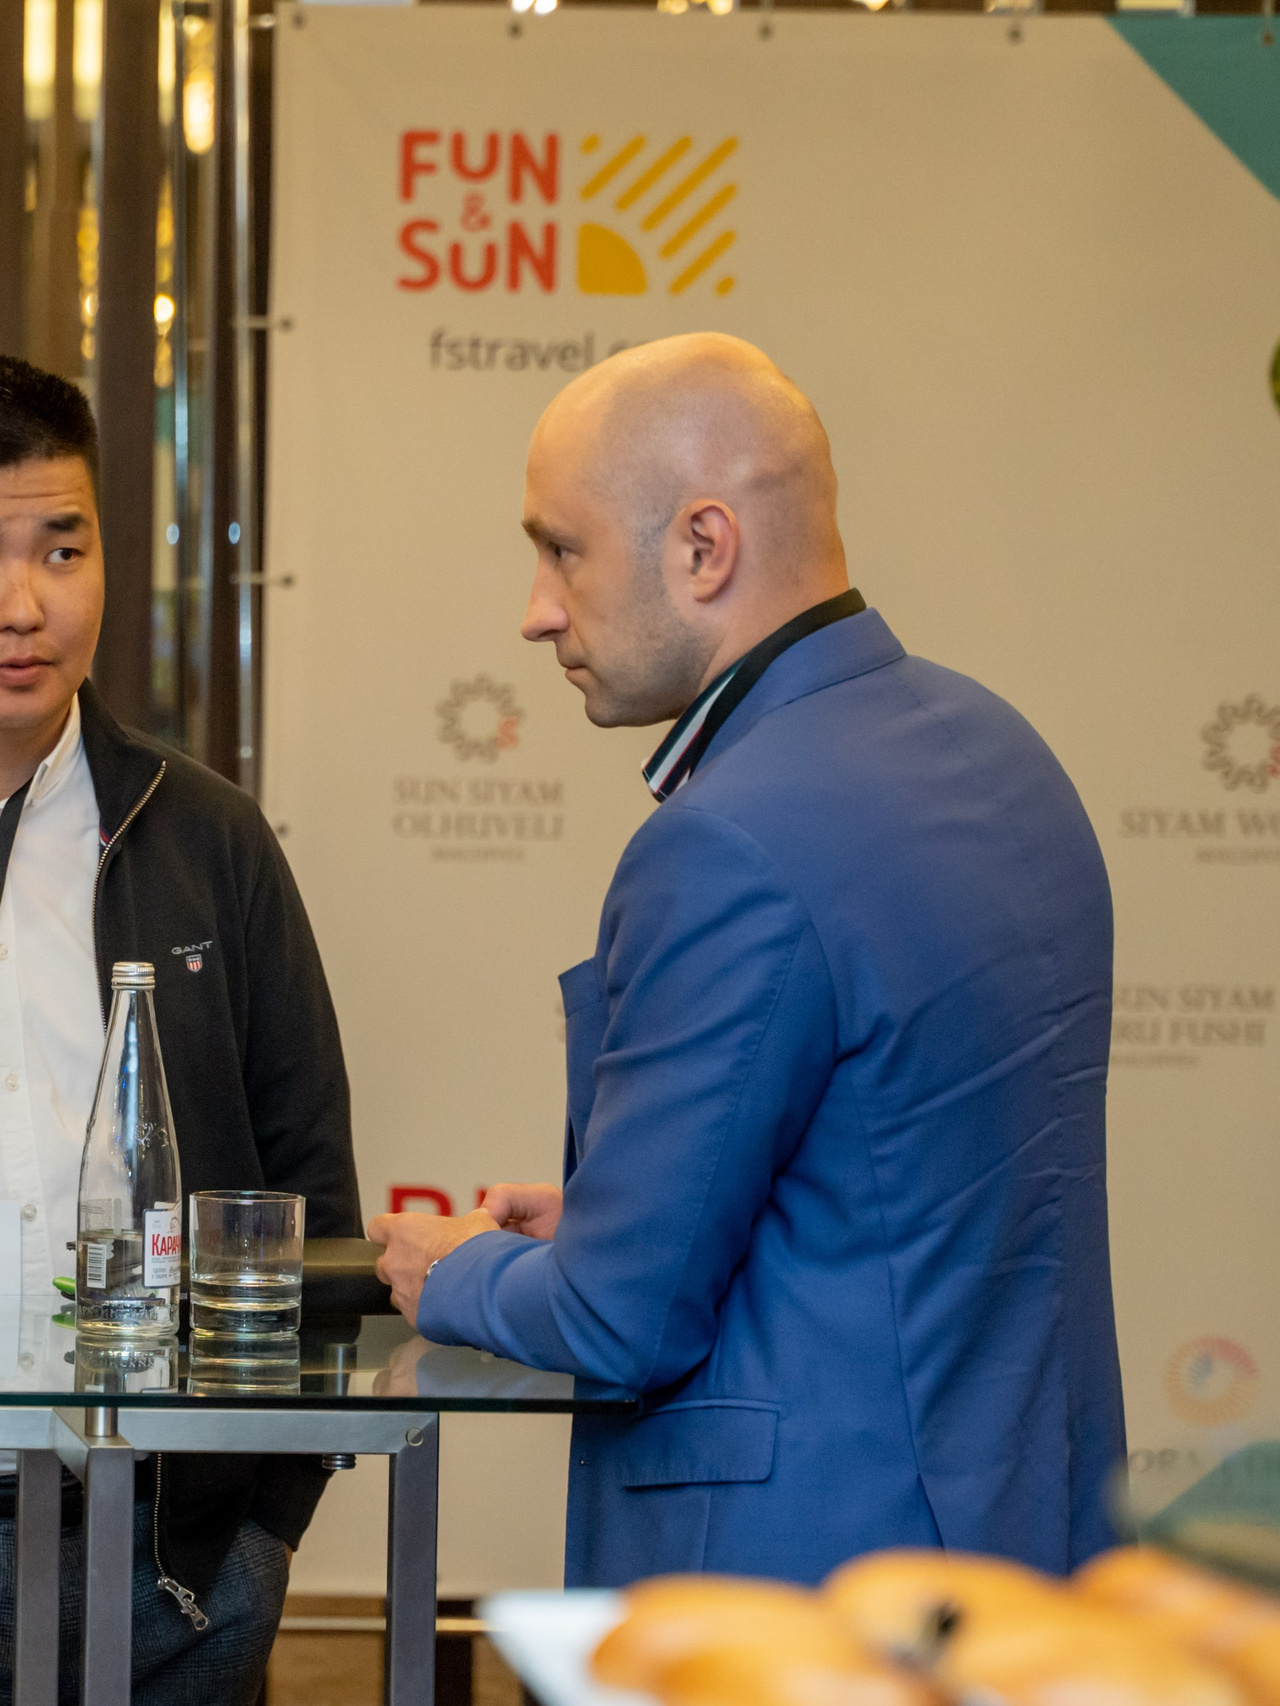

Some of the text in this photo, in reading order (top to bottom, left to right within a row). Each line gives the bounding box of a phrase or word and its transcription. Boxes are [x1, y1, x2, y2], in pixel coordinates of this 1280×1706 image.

[400, 130, 559, 204] FUN
[460, 191, 492, 232] &
[430, 328, 632, 372] fstravel
[171, 940, 214, 955] GANT
[1113, 984, 1169, 1013] UN
